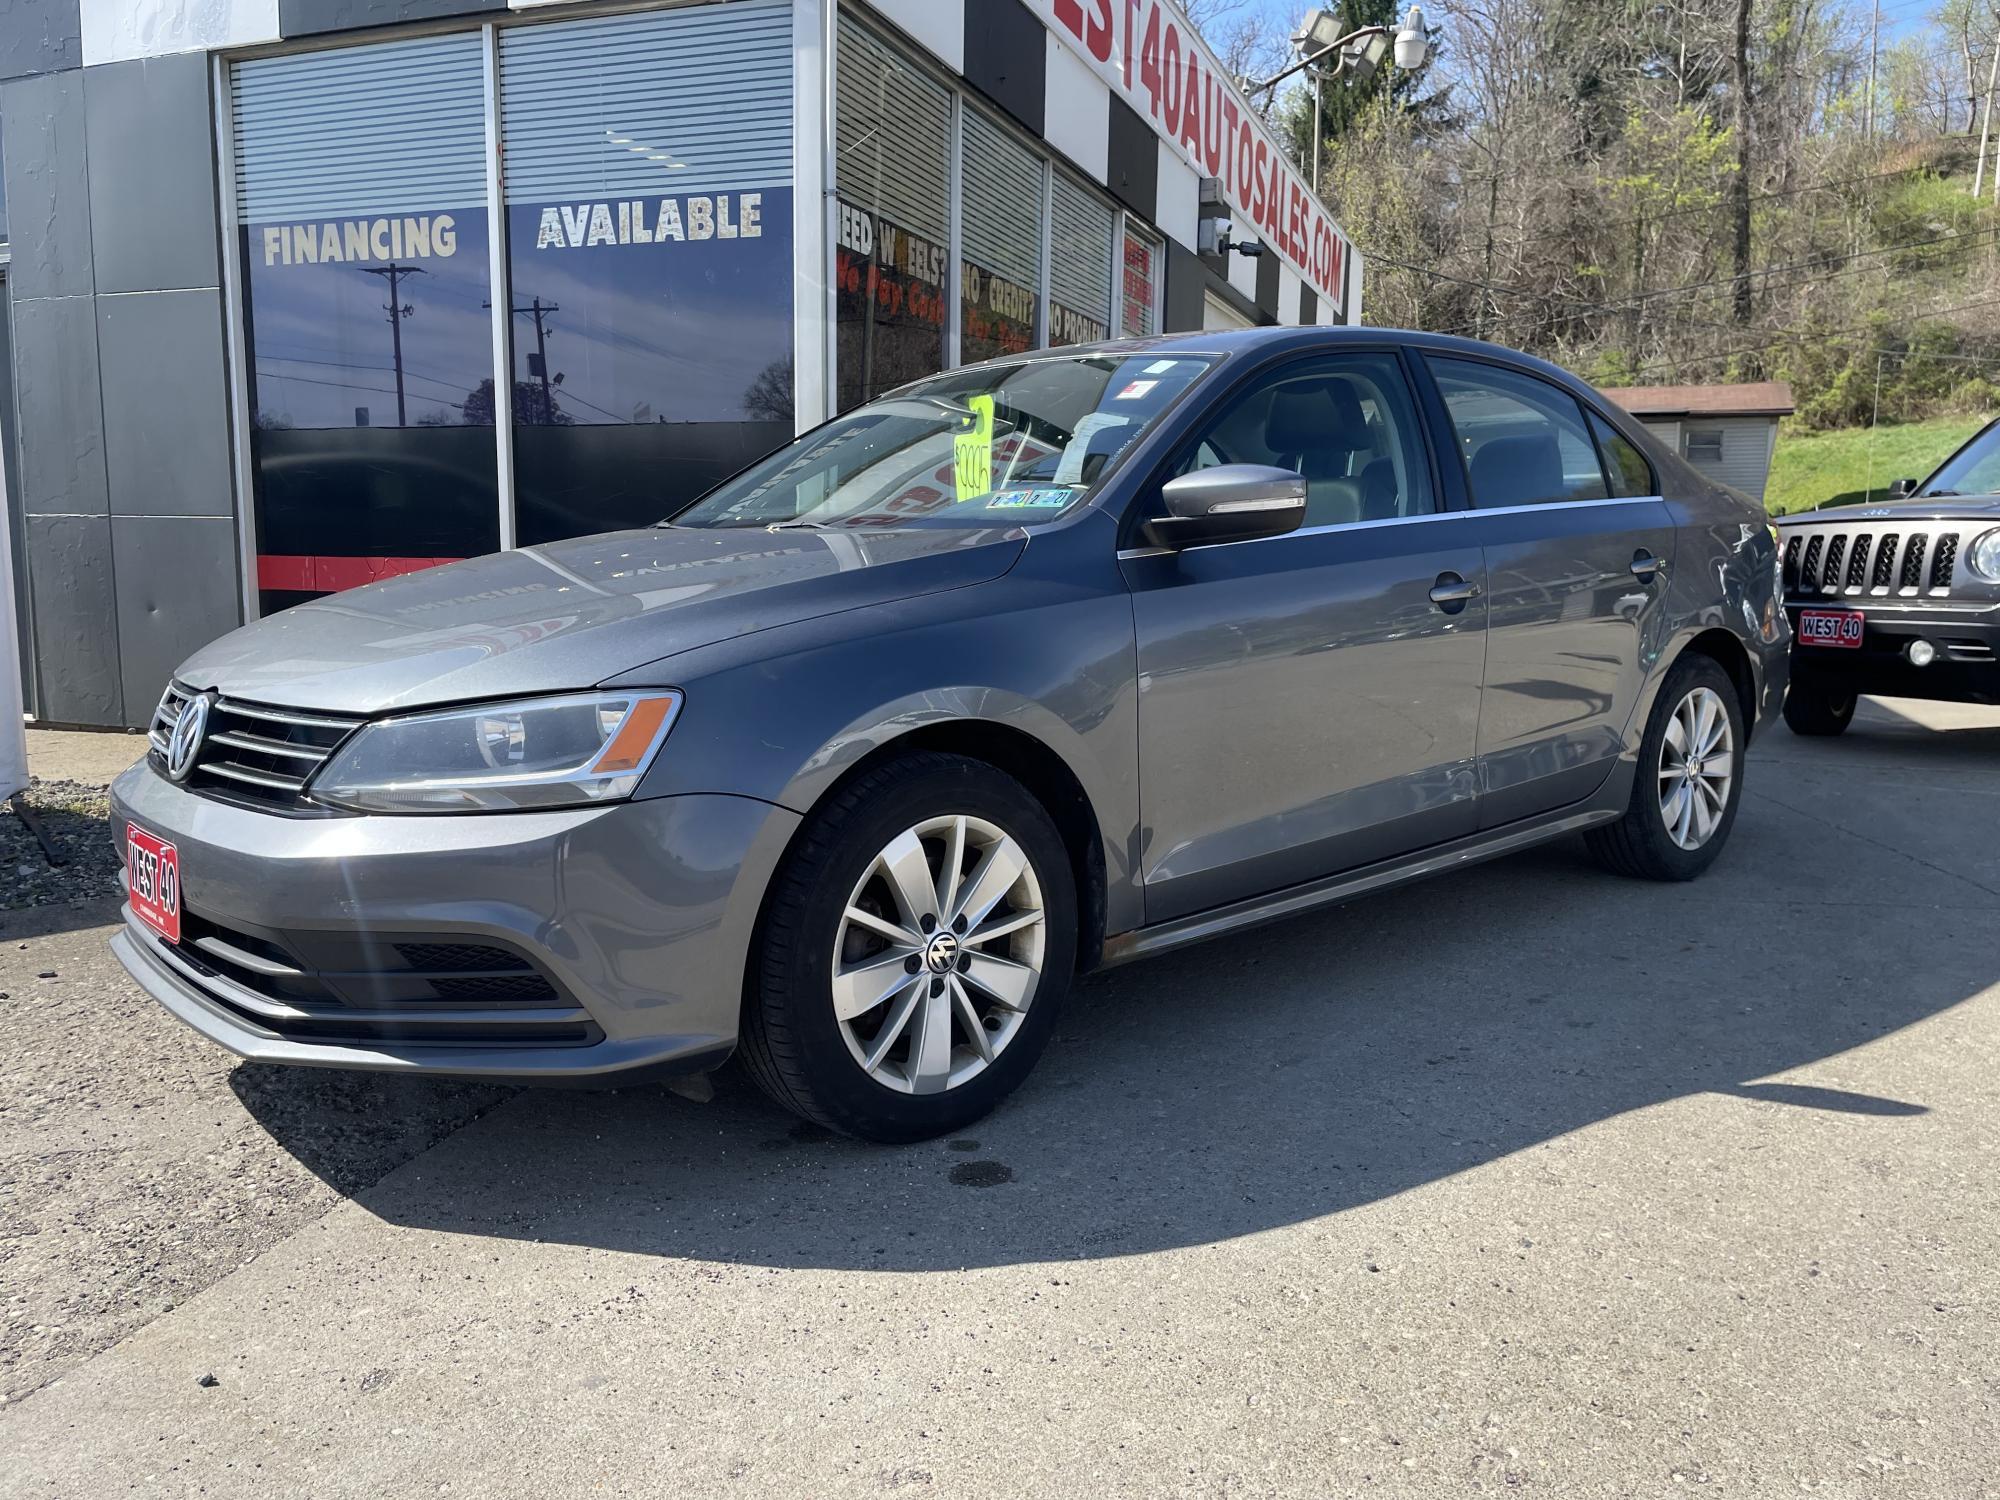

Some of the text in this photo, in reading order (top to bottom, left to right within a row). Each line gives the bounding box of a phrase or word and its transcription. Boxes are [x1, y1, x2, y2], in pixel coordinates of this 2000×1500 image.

[1054, 0, 1342, 303] T40AUTOSALES.COM
[263, 193, 762, 266] FINANCING AVAILABLE
[961, 260, 1035, 327] NO CREDIT?
[1049, 303, 1062, 337] NO
[1802, 616, 1861, 639] WEST 40
[128, 839, 176, 917] WEST 40
